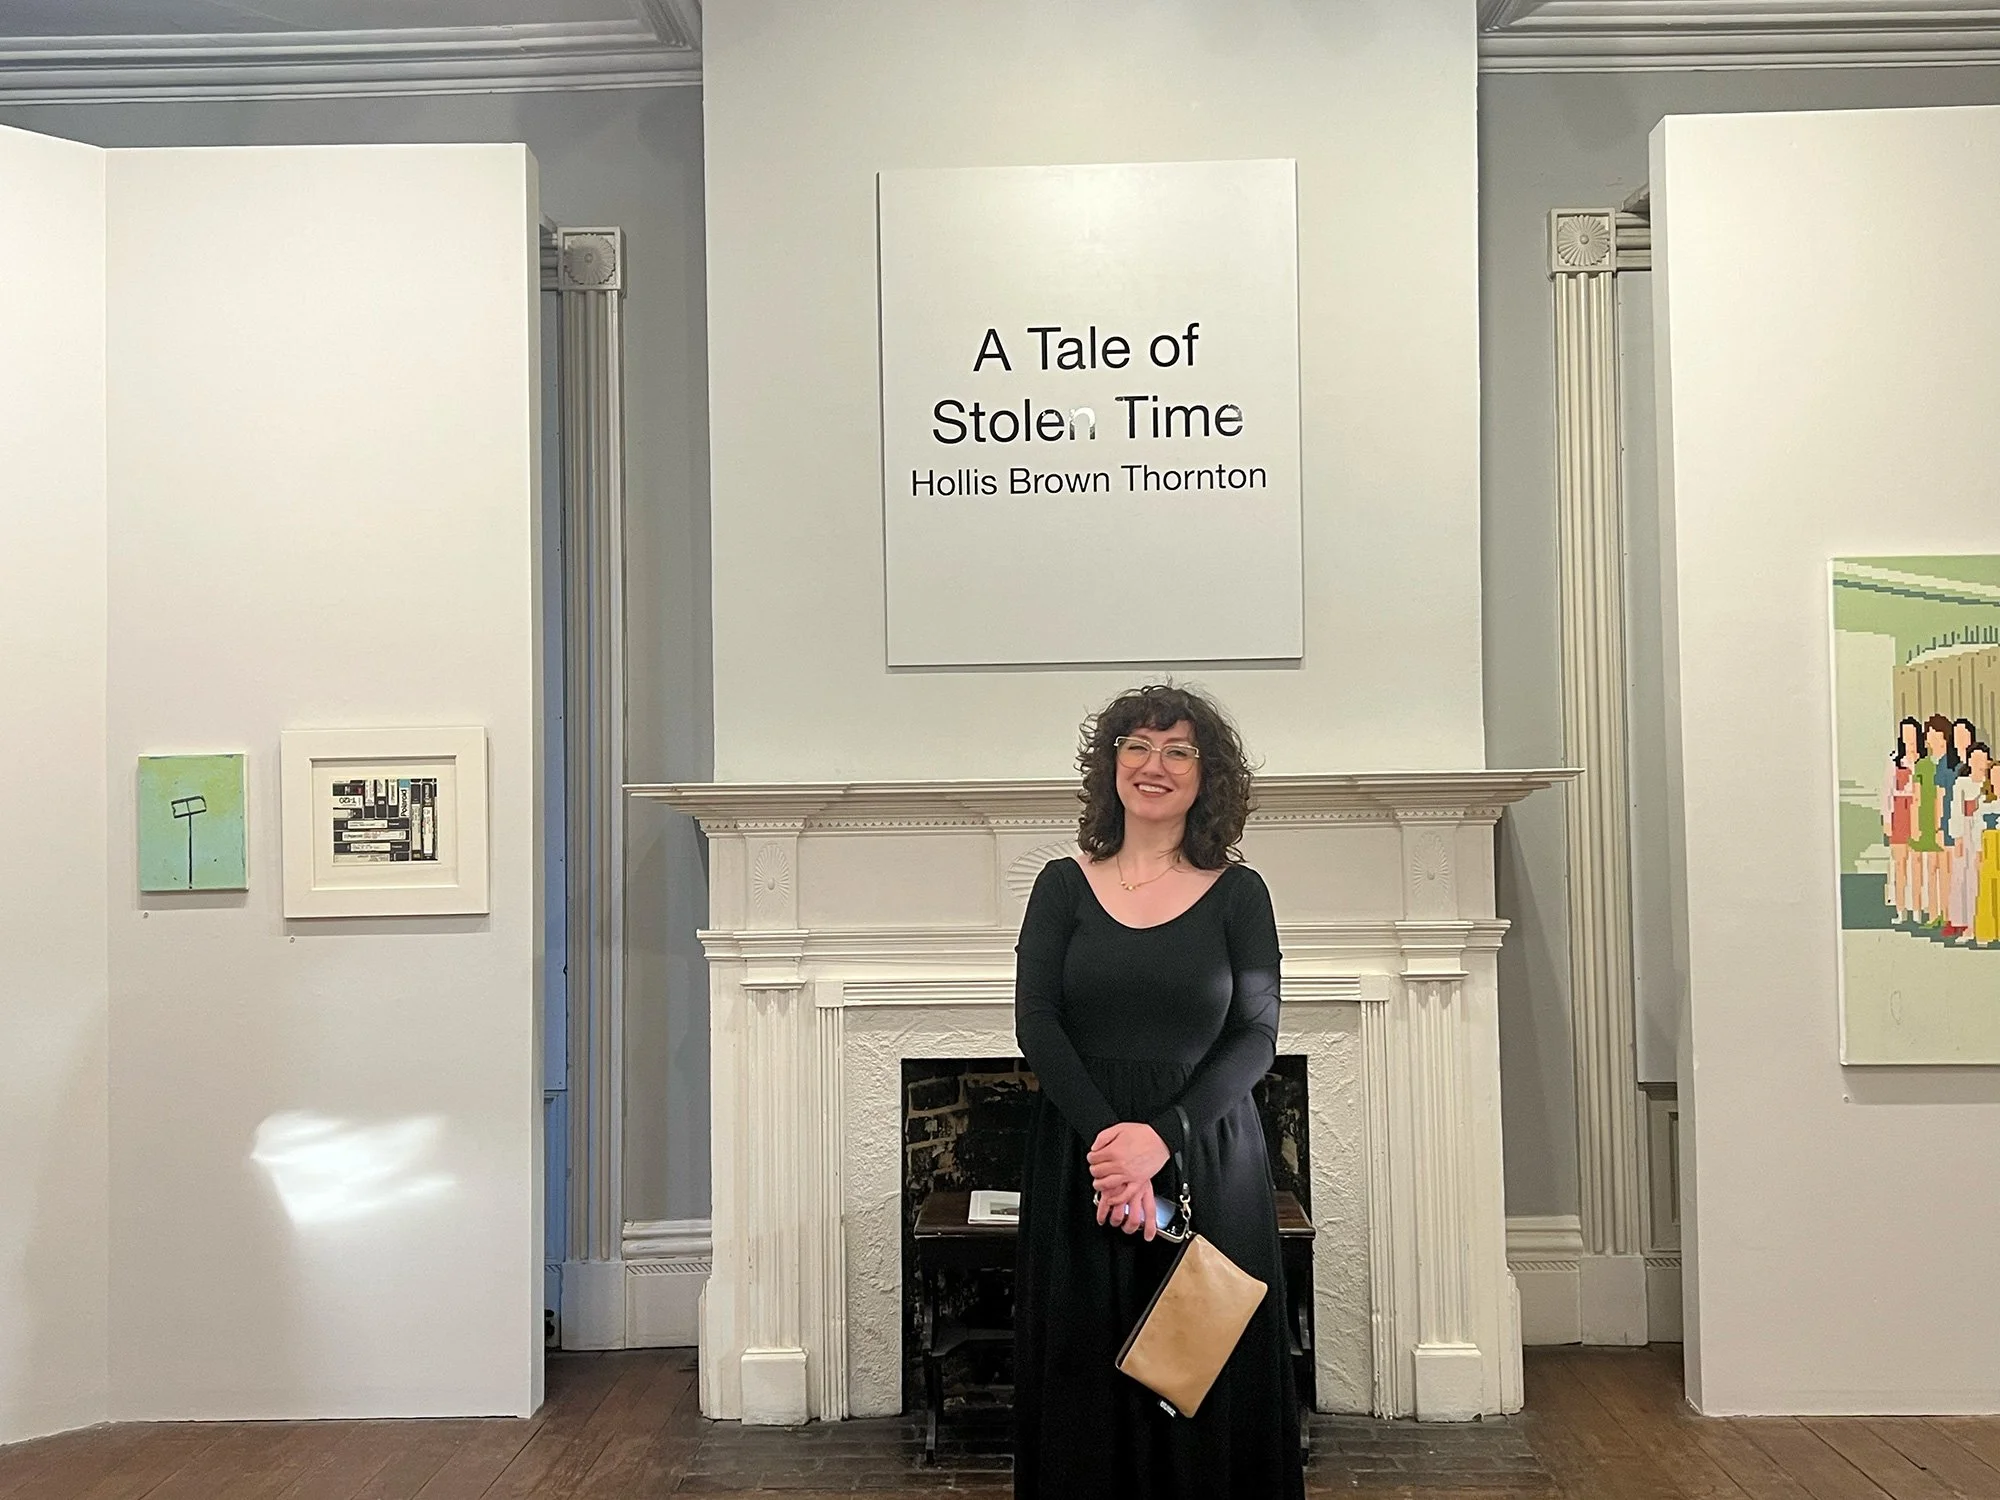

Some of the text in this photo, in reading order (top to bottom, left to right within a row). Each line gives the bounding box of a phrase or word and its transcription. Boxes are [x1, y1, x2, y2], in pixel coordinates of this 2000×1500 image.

[972, 322, 1200, 372] A Tale of
[932, 395, 1243, 445] Stolen Time
[911, 463, 1267, 497] Hollis Brown Thornton
